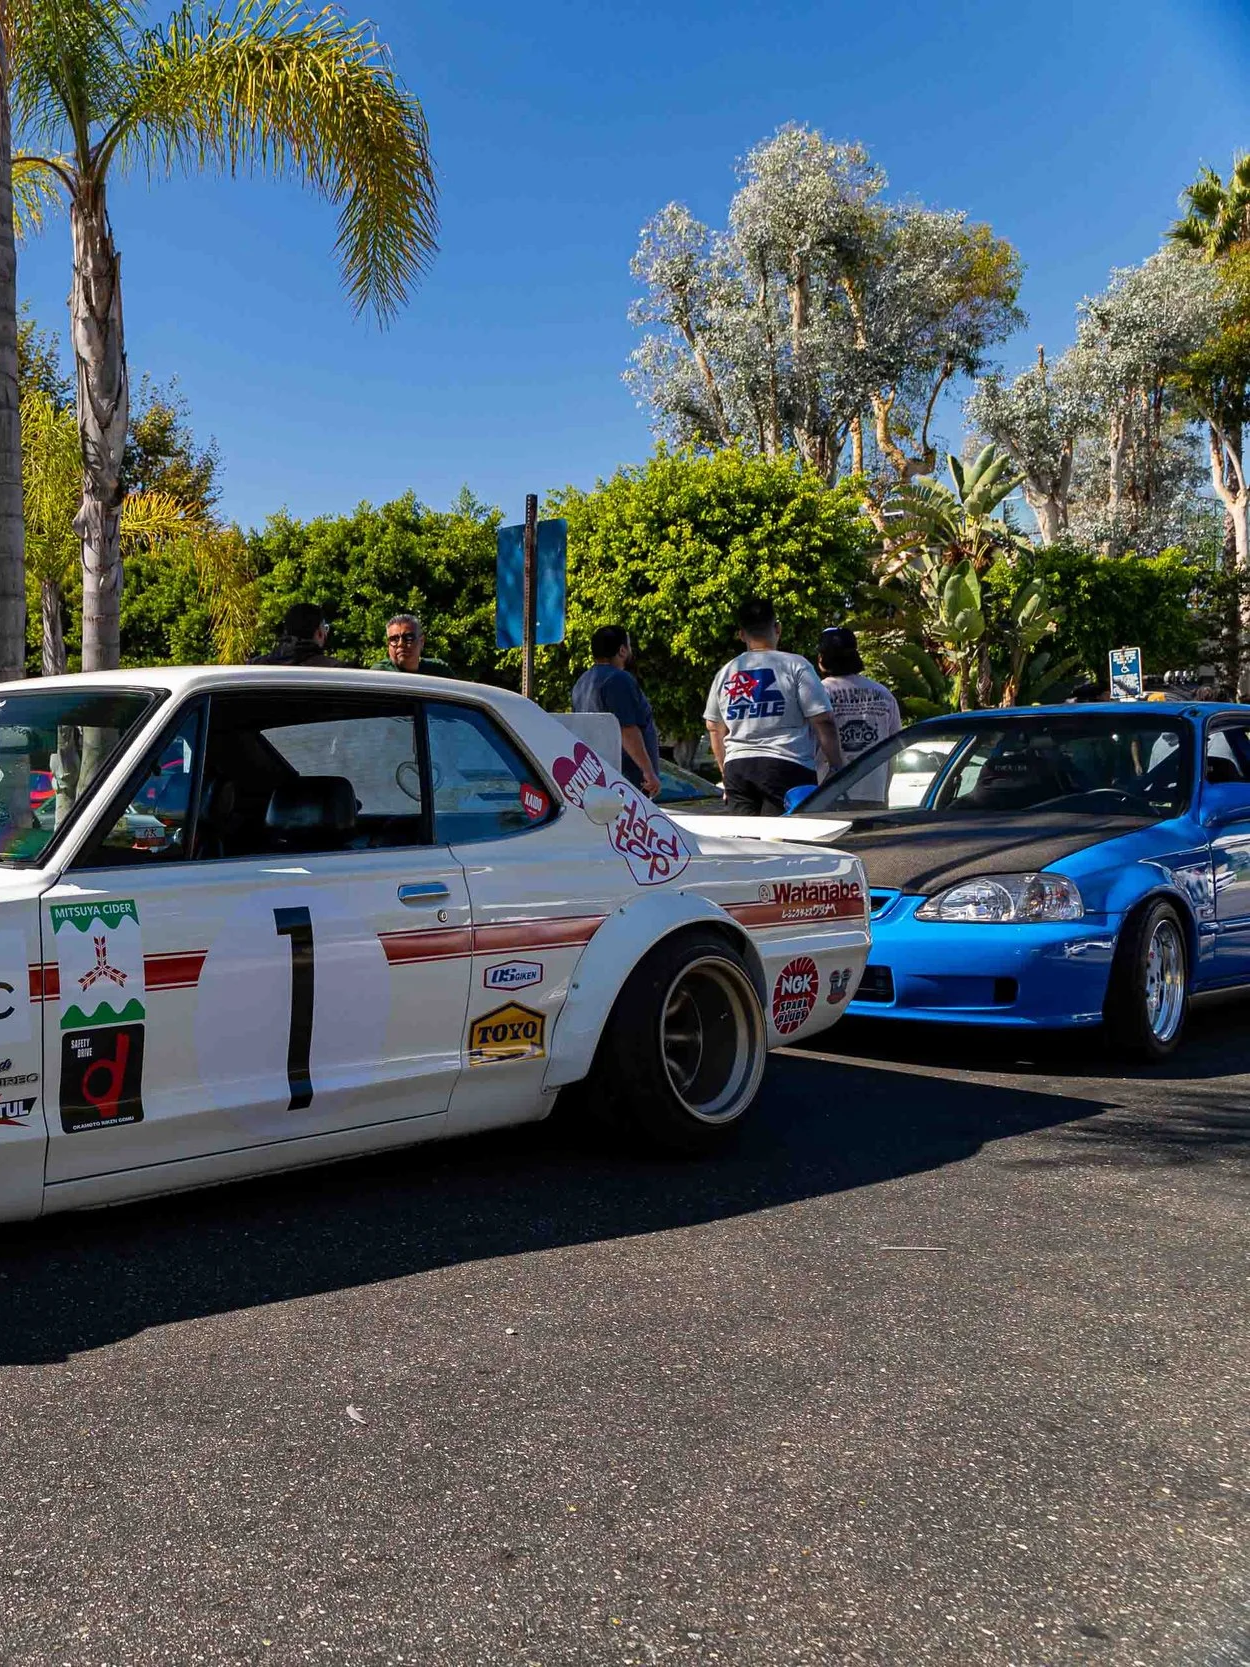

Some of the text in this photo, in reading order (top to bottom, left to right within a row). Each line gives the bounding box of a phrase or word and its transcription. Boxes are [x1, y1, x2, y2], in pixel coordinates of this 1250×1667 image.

[726, 701, 786, 720] STYLE
[772, 879, 860, 904] Watanabe
[54, 903, 133, 919] MITSUYA CIDER
[491, 968, 537, 983] OS GIKEN
[780, 973, 813, 996] NGK
[273, 906, 315, 1111] 1
[780, 998, 808, 1012] SPARK
[777, 1008, 808, 1023] PLUGS
[478, 1020, 538, 1044] TOYO
[70, 1038, 90, 1049] SAFETY
[77, 1047, 93, 1058] DRIVE
[72, 1121, 101, 1131] OKAMOTO
